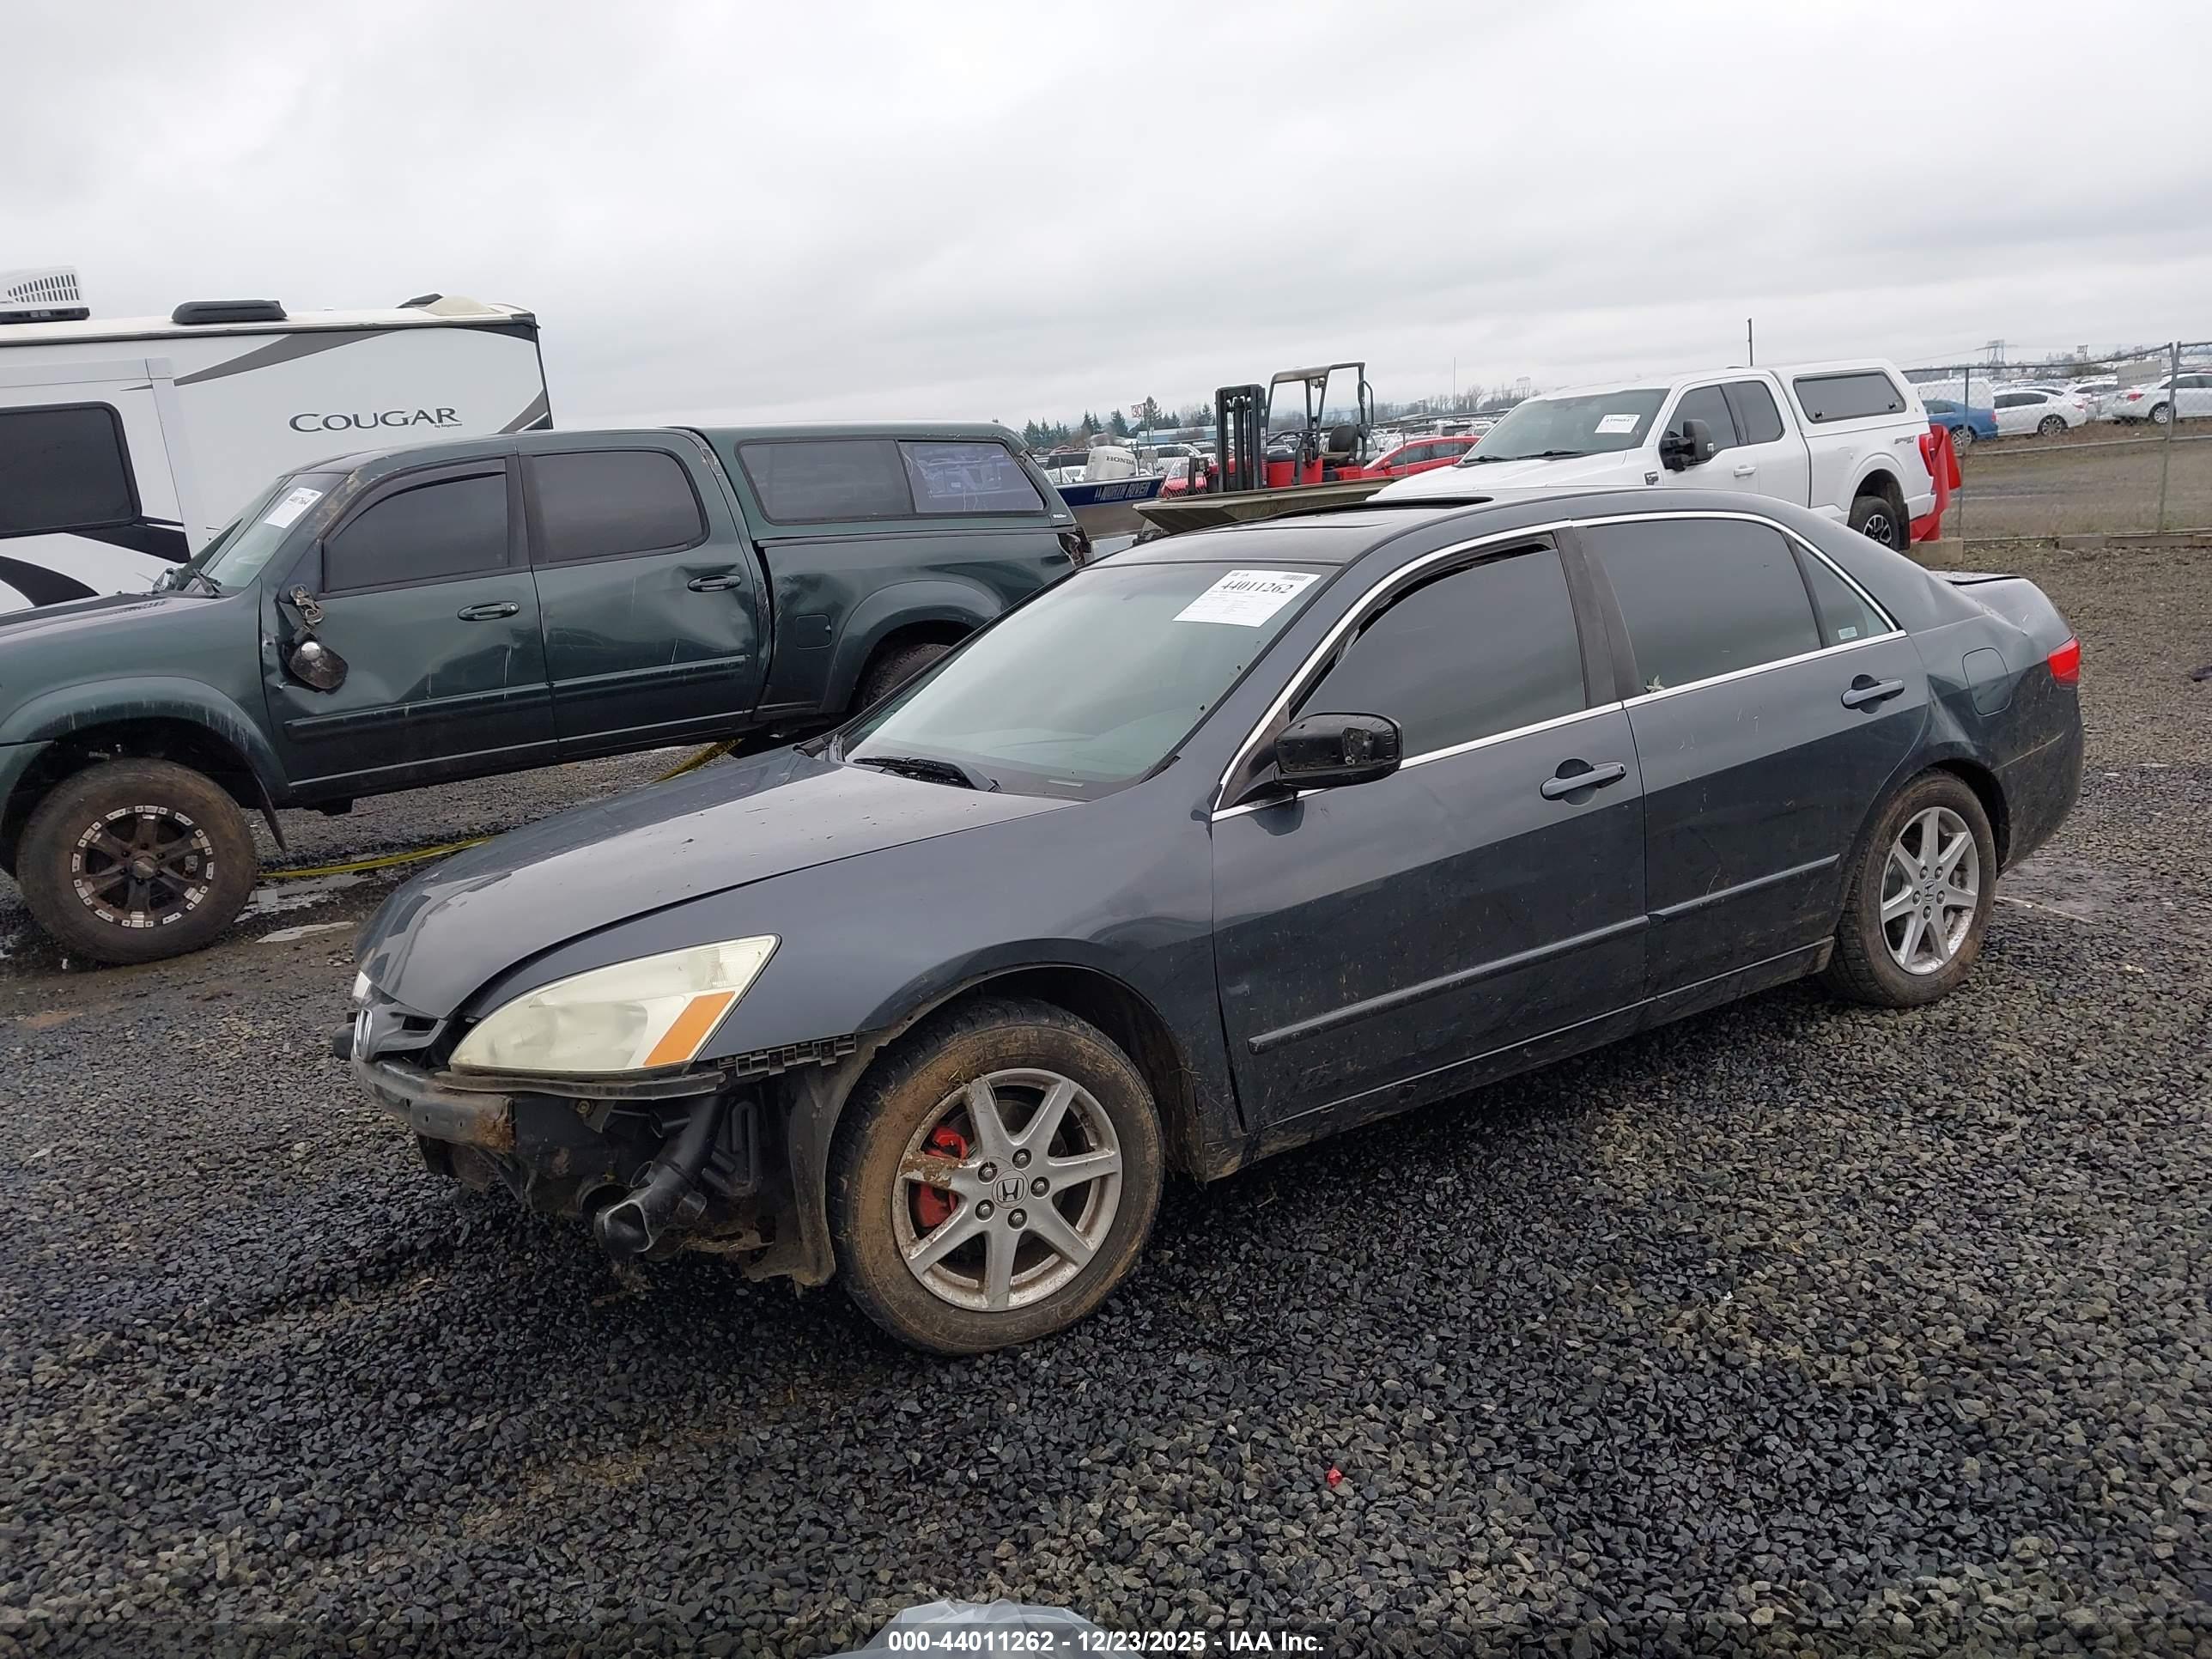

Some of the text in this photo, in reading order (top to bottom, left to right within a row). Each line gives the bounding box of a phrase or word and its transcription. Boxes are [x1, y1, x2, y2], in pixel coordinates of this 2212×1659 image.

[289, 407, 462, 433] COUGAR
[1099, 482, 1152, 501] NORTH RIVER
[1220, 580, 1294, 594] 44011262
